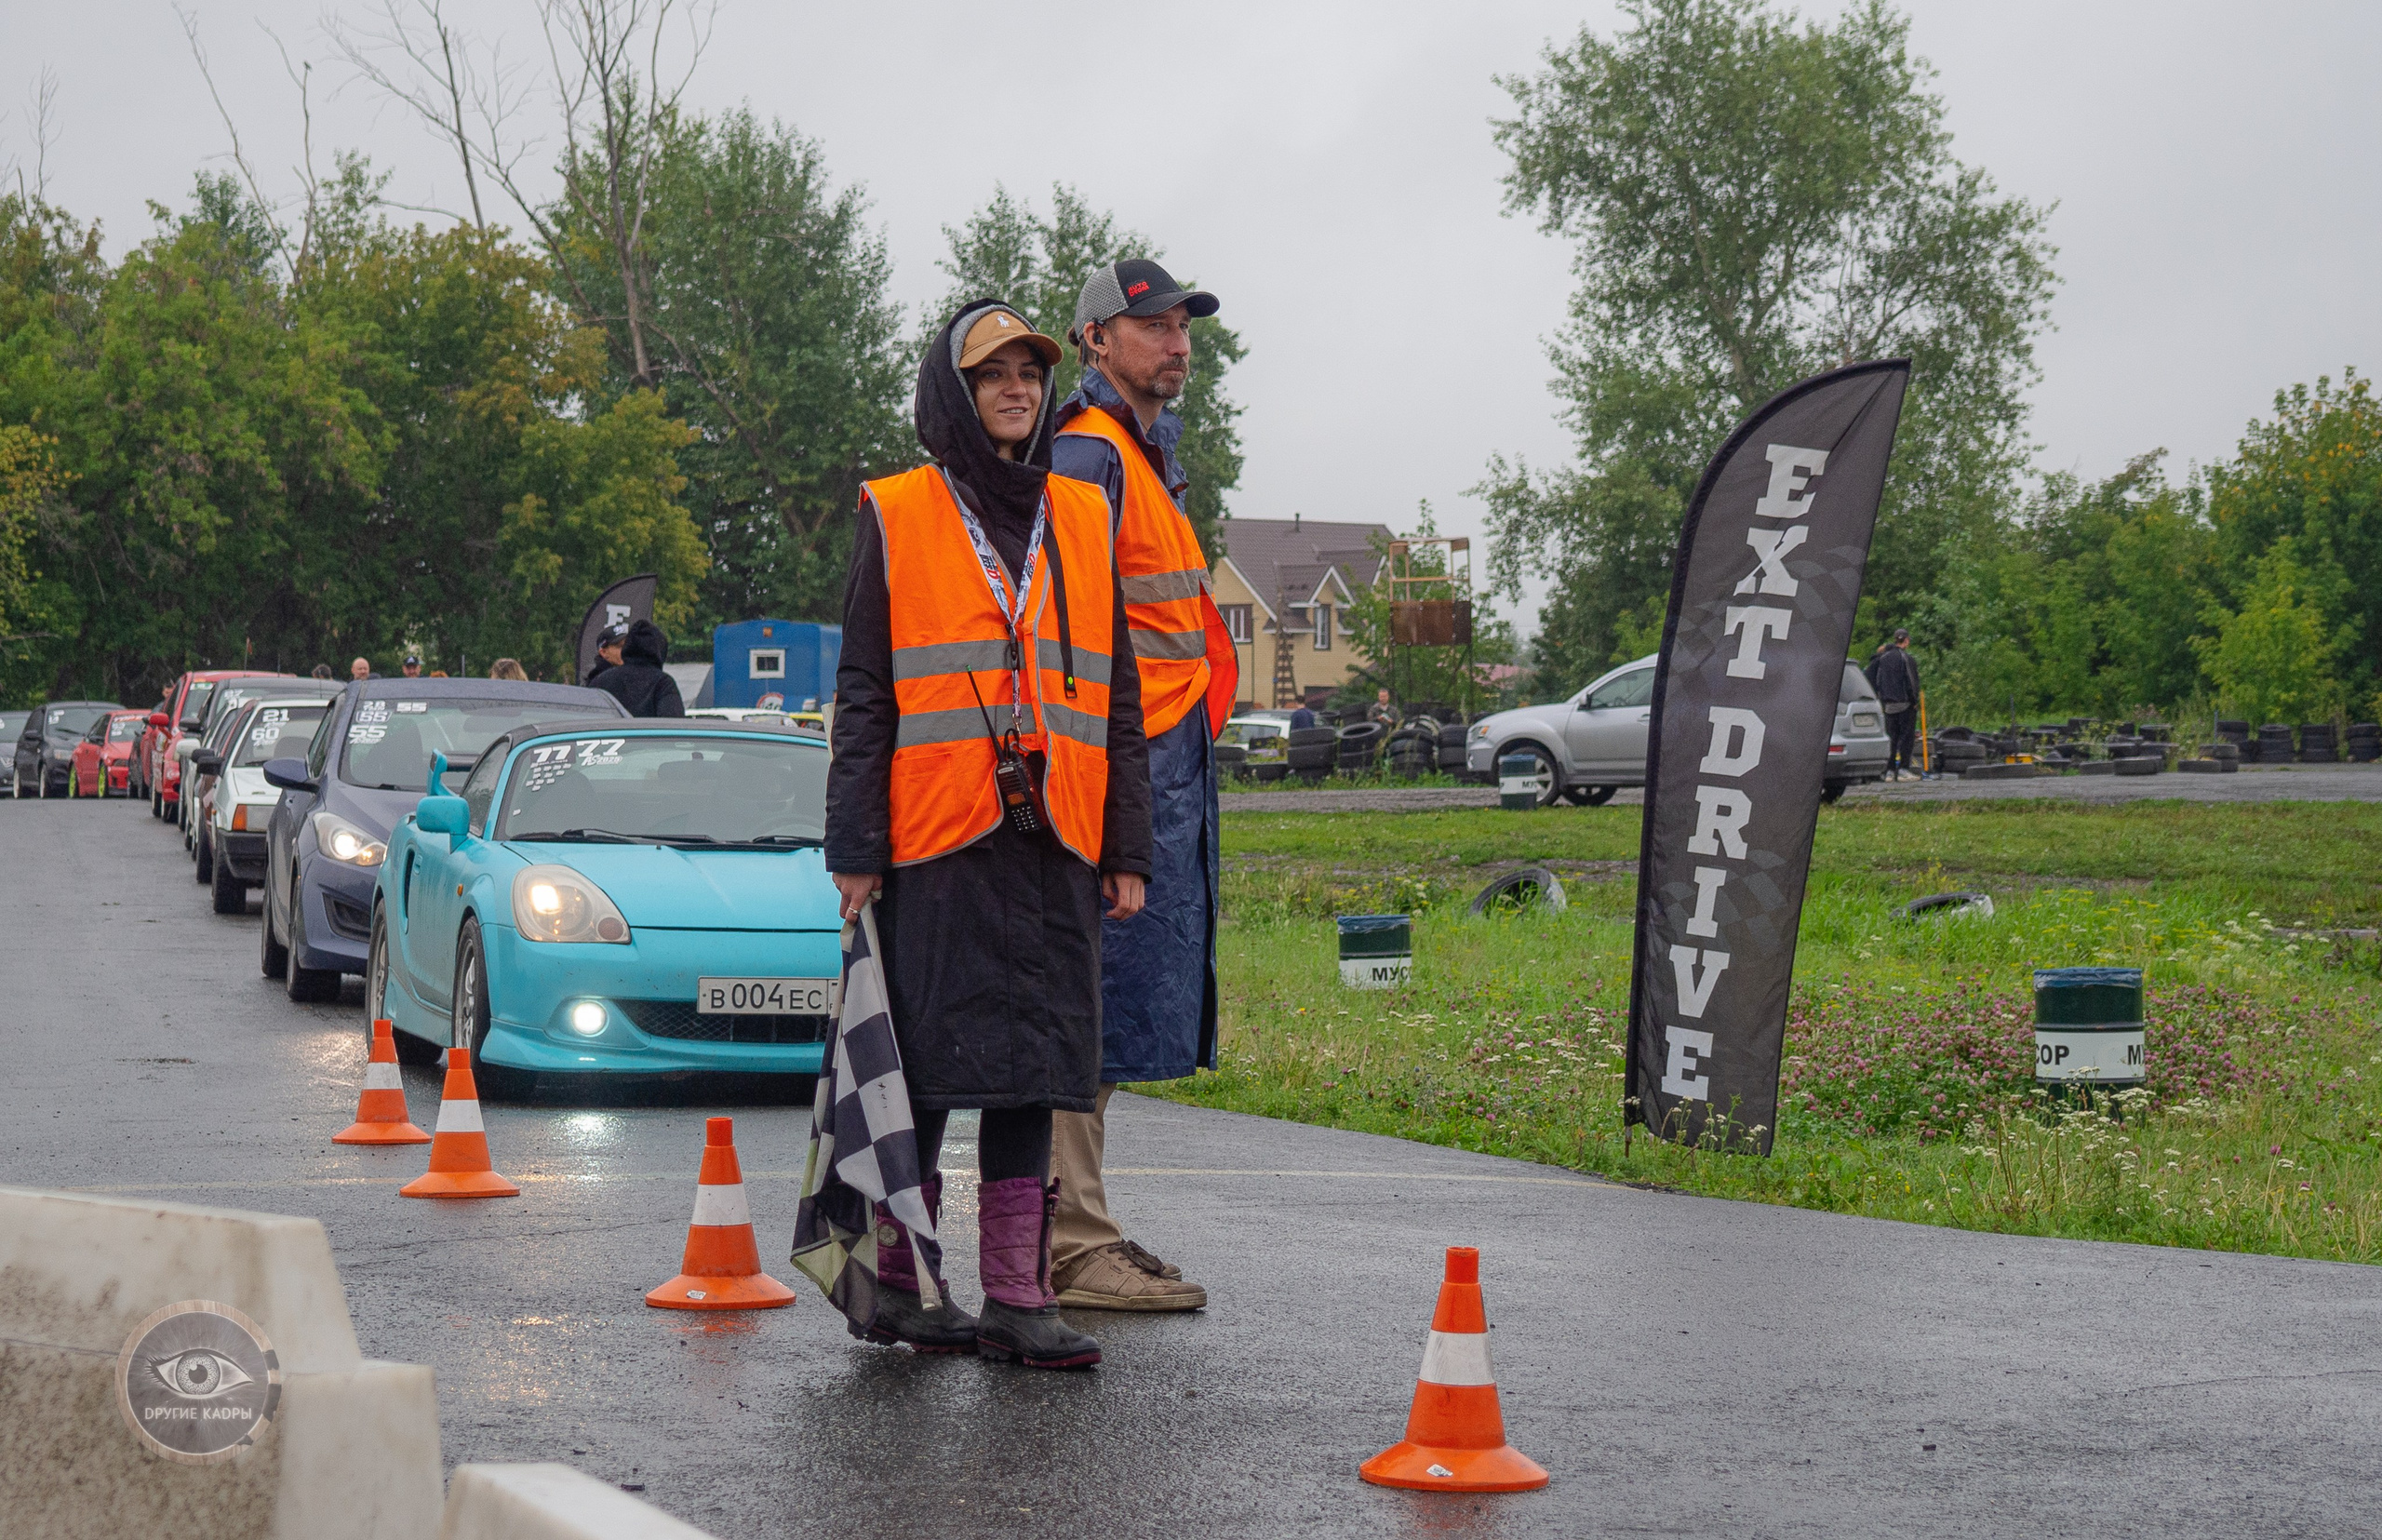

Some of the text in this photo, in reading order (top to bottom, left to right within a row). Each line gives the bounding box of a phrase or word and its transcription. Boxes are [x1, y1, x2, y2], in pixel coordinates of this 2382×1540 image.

[262, 709, 289, 723] 21
[251, 727, 279, 741] 60
[348, 726, 387, 738] 55
[534, 745, 571, 763] 77
[576, 739, 625, 757] 77
[1662, 705, 1766, 1102] DRIVE
